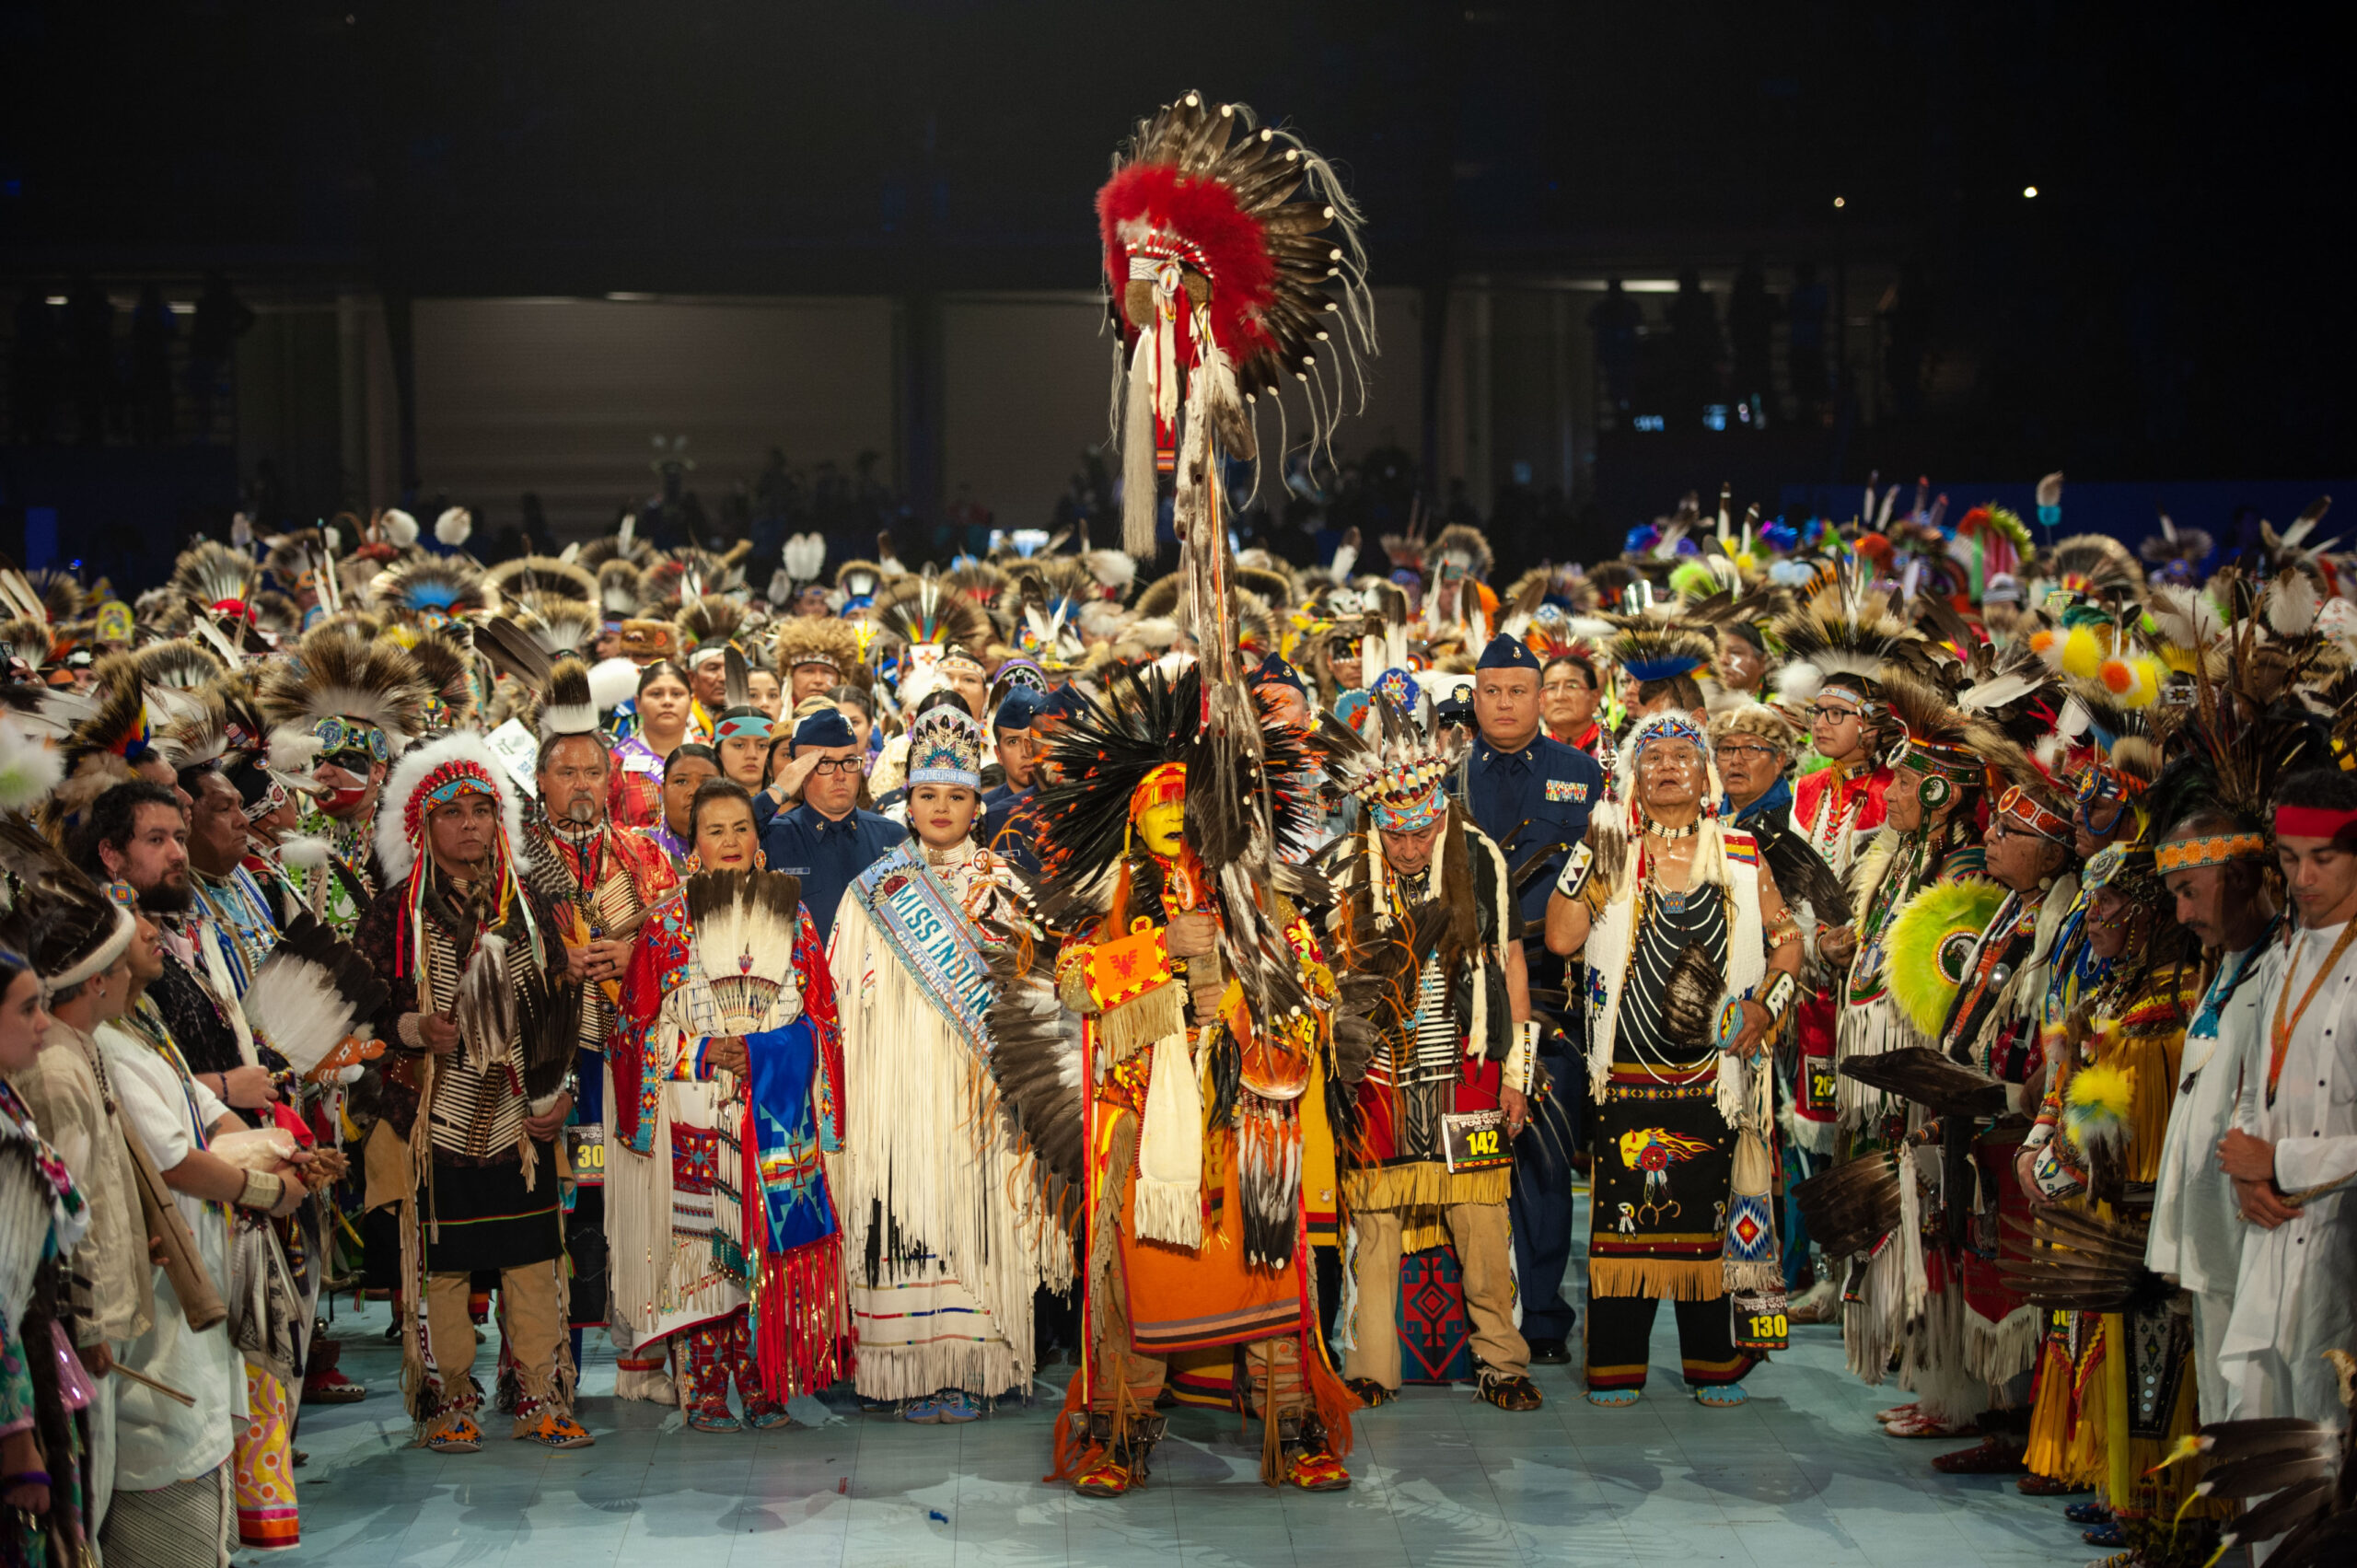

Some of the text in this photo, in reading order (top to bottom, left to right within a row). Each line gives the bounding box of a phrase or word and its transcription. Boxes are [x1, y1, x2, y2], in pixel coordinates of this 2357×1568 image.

[889, 884, 995, 1016] MISS INDIAN
[894, 929, 955, 1003] GATHERING
[1814, 1074, 1836, 1097] 26
[1459, 1120, 1481, 1128] POW
[1466, 1130, 1499, 1156] 142
[1748, 1314, 1788, 1338] 130
